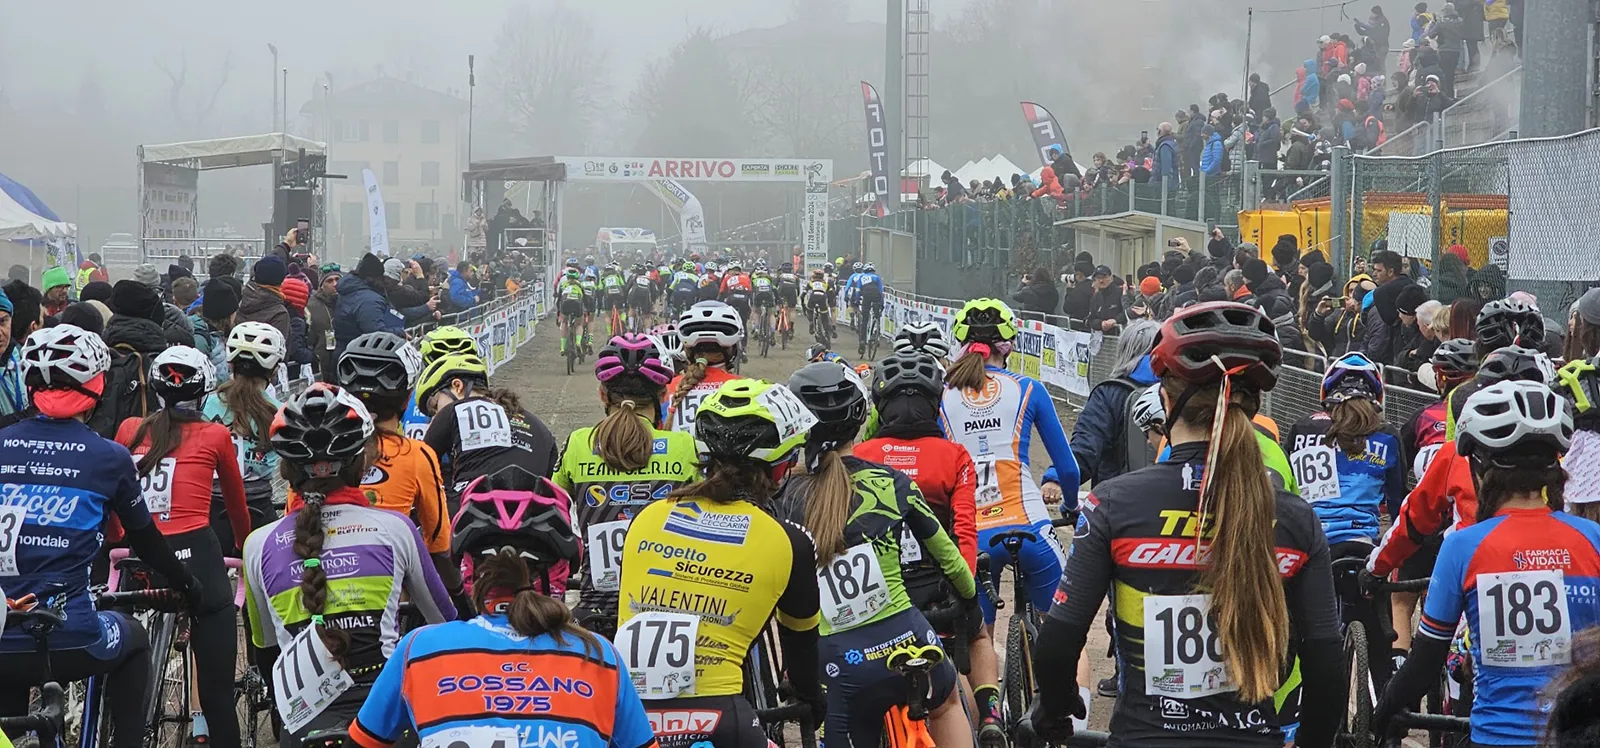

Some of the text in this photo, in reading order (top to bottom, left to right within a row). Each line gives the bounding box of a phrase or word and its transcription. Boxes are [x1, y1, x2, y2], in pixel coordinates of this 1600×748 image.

[867, 103, 888, 195] FOTO
[648, 160, 736, 178] ARRIVO
[462, 405, 504, 430] 161
[964, 418, 1001, 432] PAVAN
[0, 465, 80, 478] BIKE RESORT
[1292, 451, 1333, 487] 163
[31, 485, 61, 494] TEAM
[701, 519, 749, 529] CECCARINI
[702, 512, 750, 523] IMPRESA
[0, 513, 17, 553] 3
[19, 535, 70, 548] nondale
[596, 528, 627, 569] 19
[637, 540, 707, 562] progetto
[1526, 556, 1571, 565] VIDALE
[675, 561, 754, 584] sicurezza
[818, 552, 880, 606] 182
[640, 585, 727, 617] VALENTINI
[1486, 580, 1562, 637] 183
[626, 620, 691, 668] 175
[863, 630, 914, 654] AUTOFFICINA
[277, 631, 324, 700] 177
[501, 662, 533, 673] G.C.
[437, 675, 594, 698] SOSSANO
[483, 695, 552, 712] 1975
